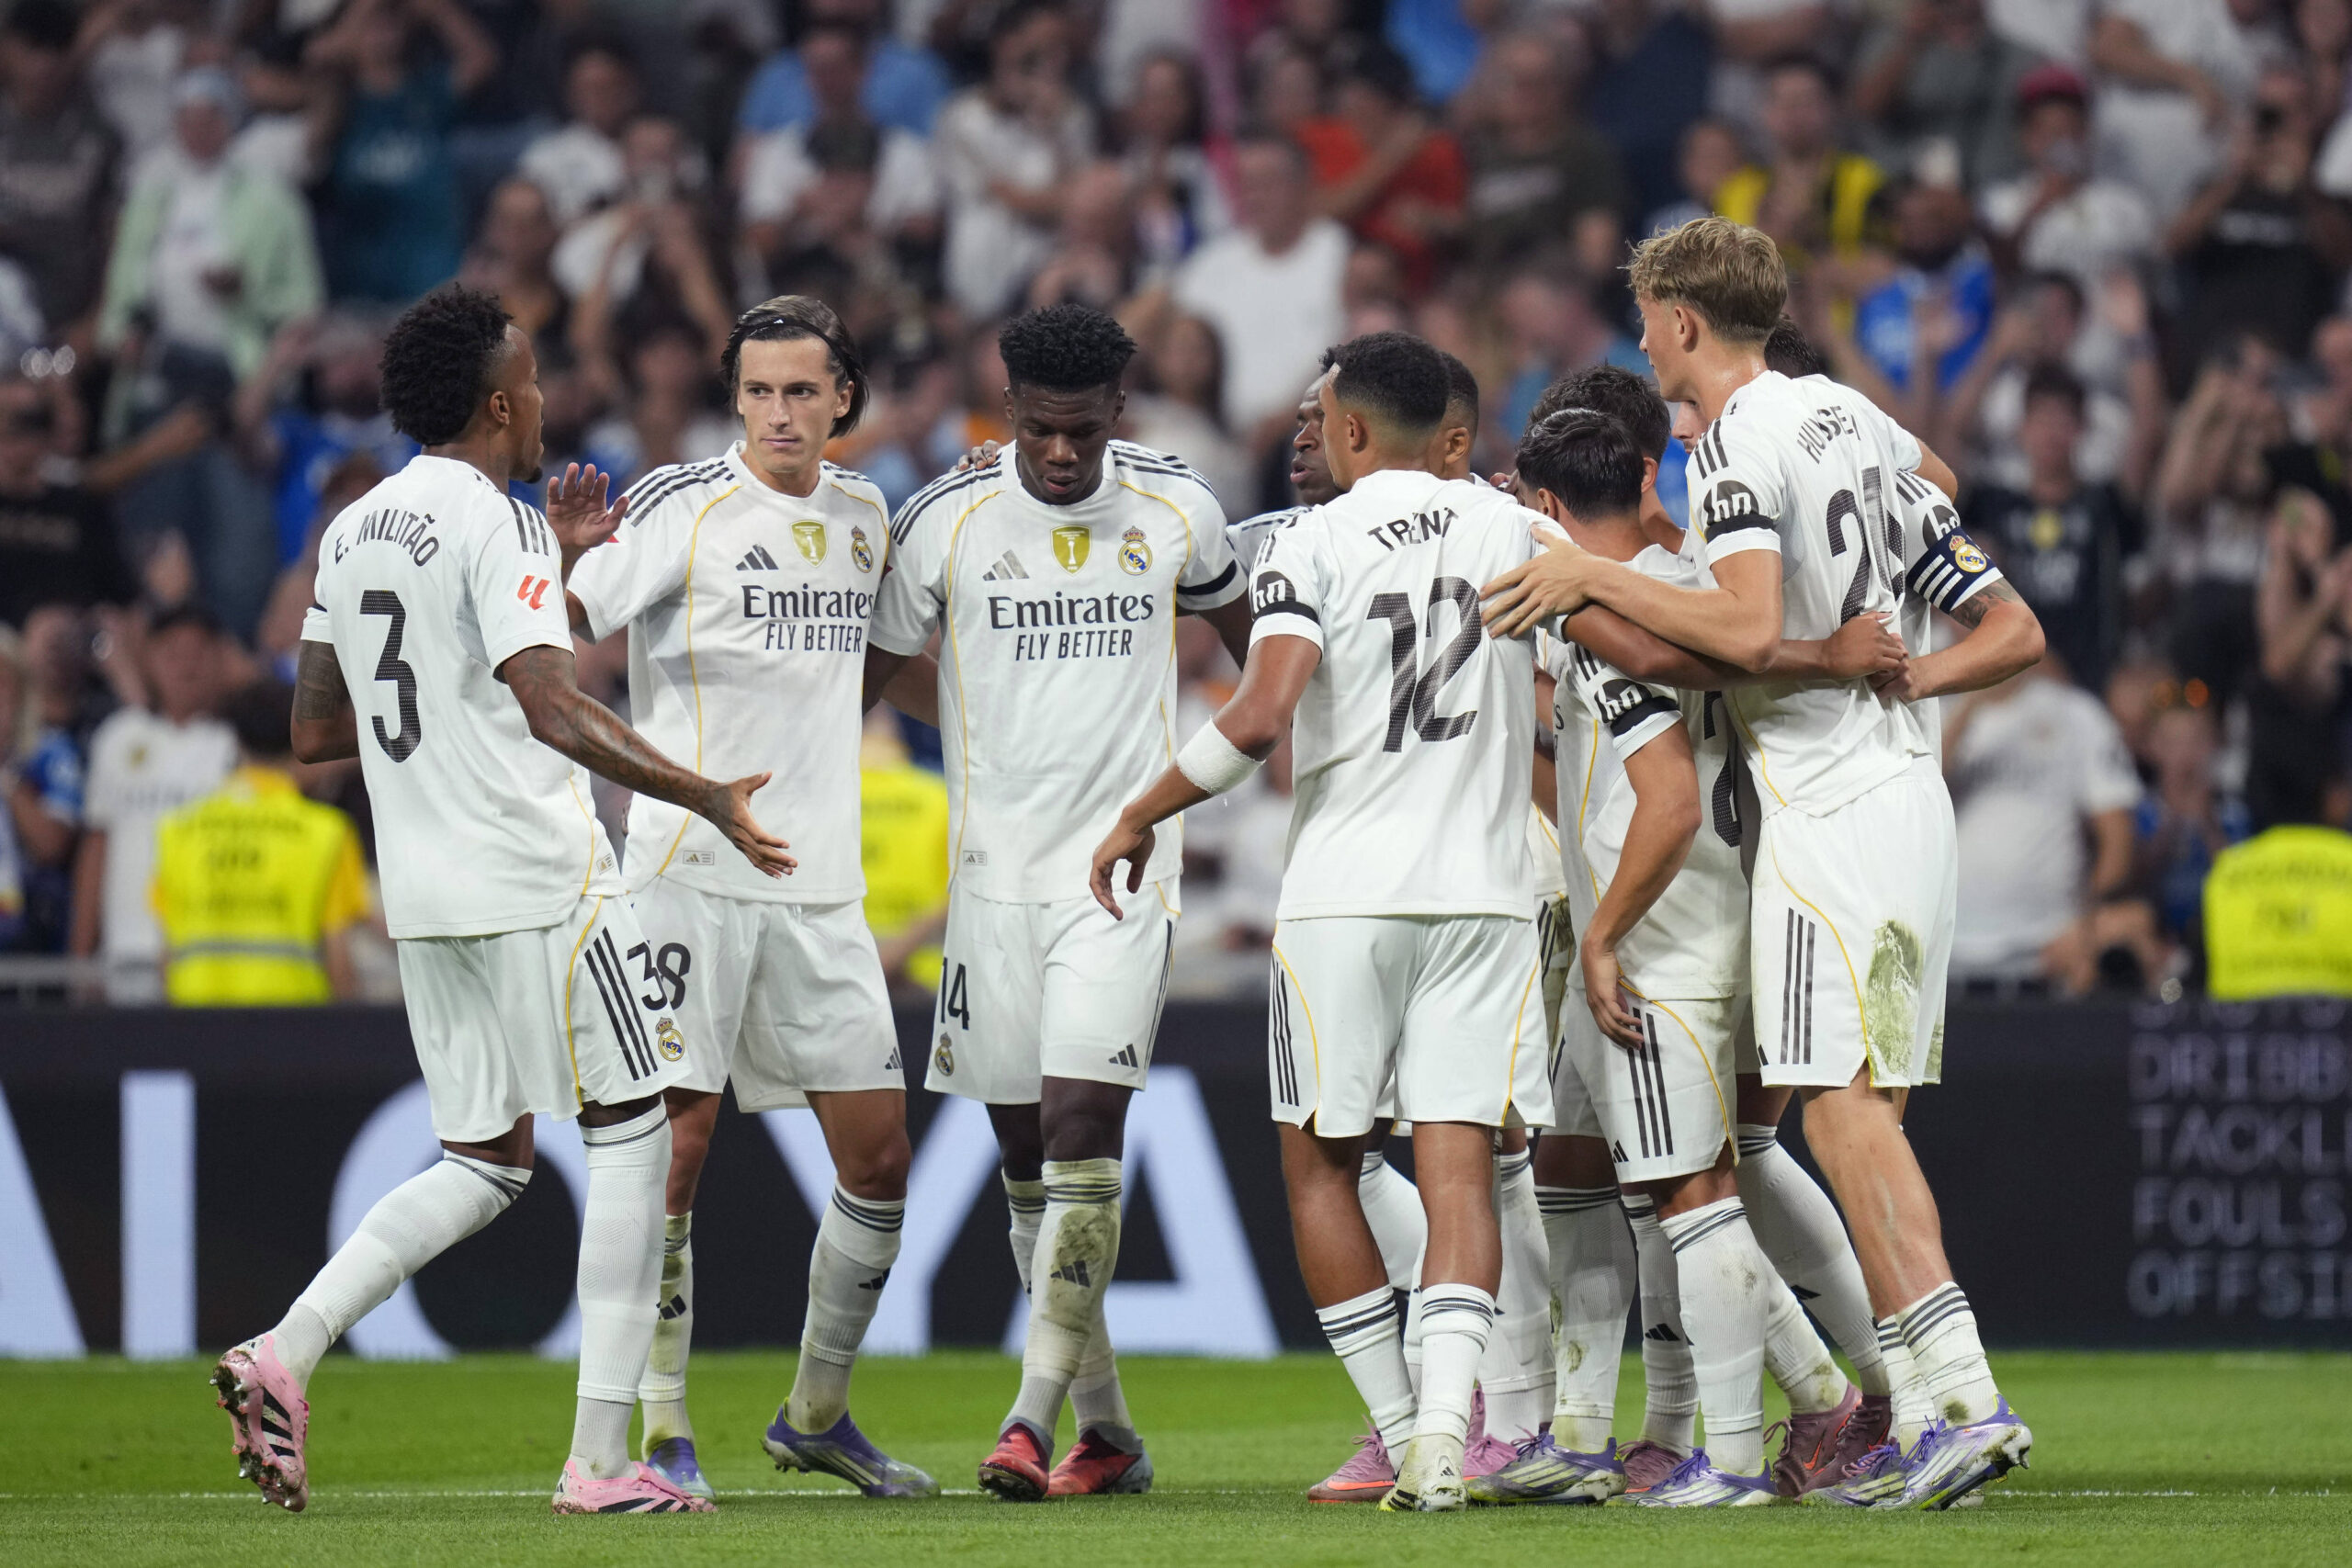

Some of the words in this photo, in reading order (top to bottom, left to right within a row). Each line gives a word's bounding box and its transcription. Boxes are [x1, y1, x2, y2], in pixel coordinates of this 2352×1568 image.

[334, 533, 350, 565] E.
[356, 508, 441, 568] MILITÃO
[741, 582, 874, 620] Emirates
[988, 591, 1155, 629] Emirates
[765, 623, 797, 650] FLY
[804, 625, 863, 653] BETTER
[1015, 633, 1050, 660] FLY
[1057, 629, 1133, 659] BETTER
[1365, 575, 1483, 753] 12
[359, 589, 423, 763] 3
[941, 956, 970, 1031] 14
[2129, 1032, 2352, 1101] DRIBB
[2130, 1105, 2352, 1176] TACKL
[2132, 1177, 2346, 1247] FOULS
[2127, 1249, 2352, 1320] OFFSI
